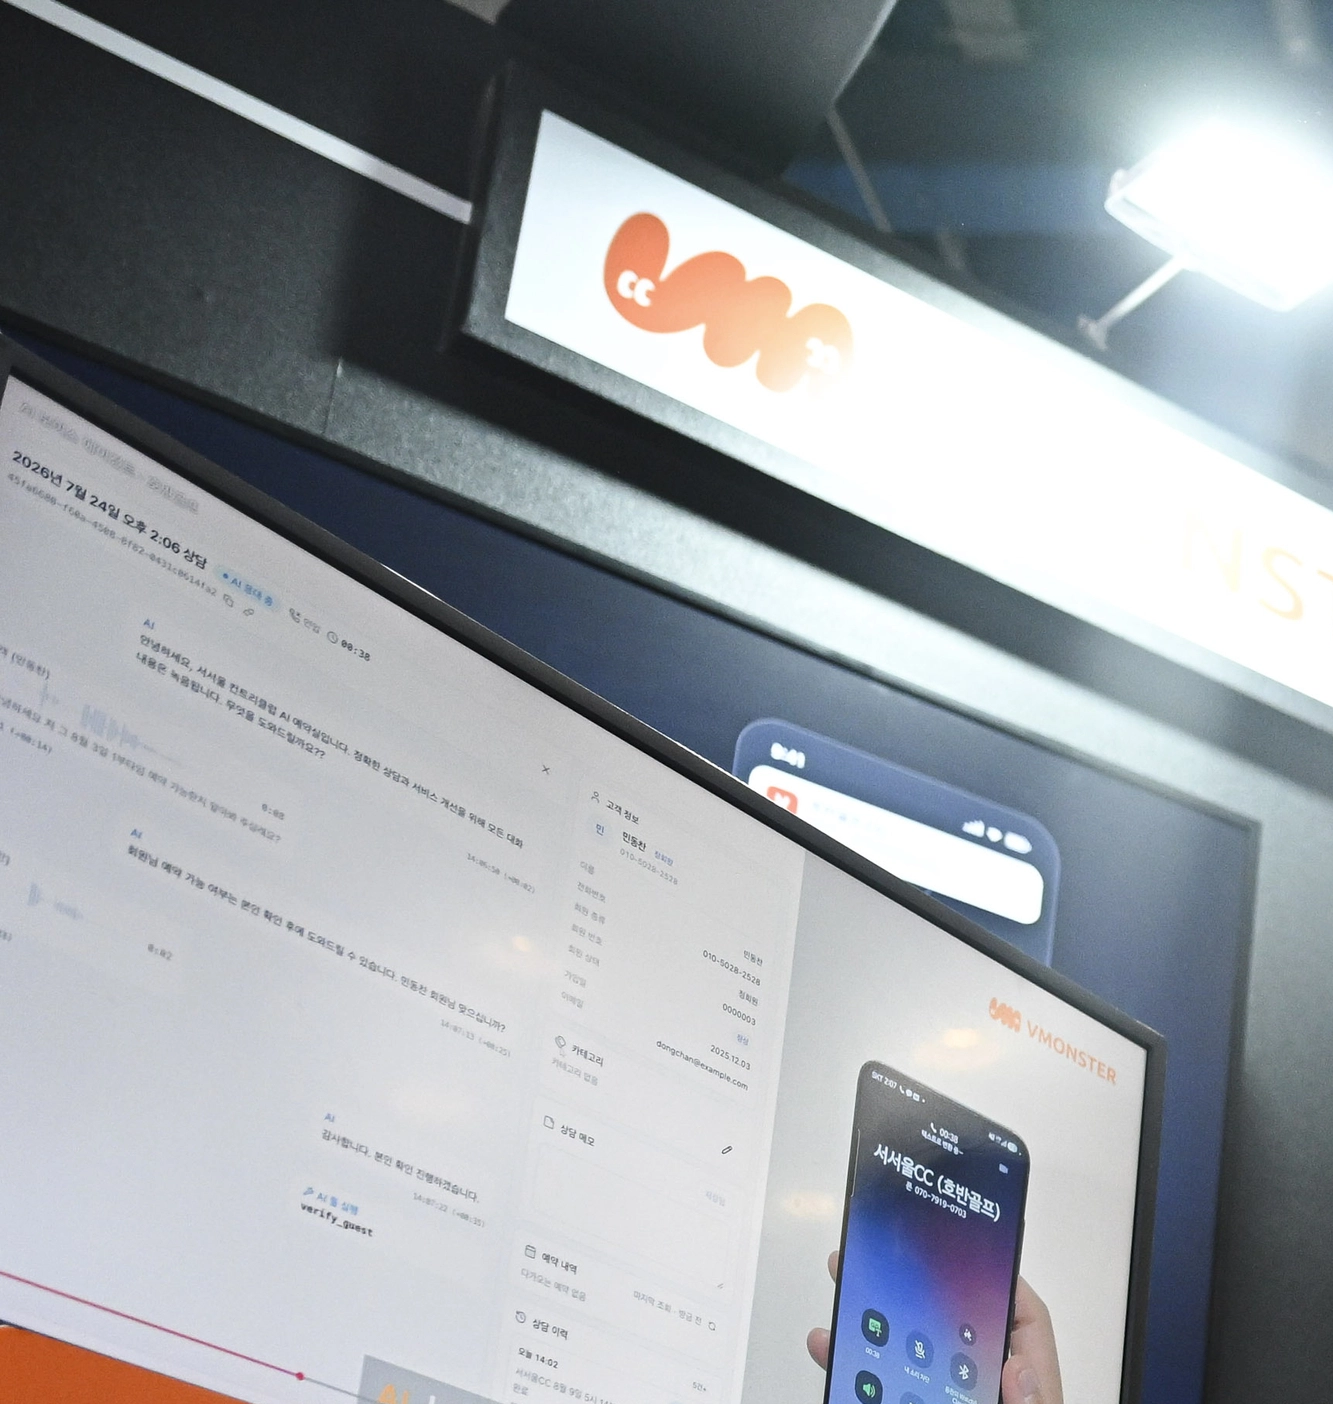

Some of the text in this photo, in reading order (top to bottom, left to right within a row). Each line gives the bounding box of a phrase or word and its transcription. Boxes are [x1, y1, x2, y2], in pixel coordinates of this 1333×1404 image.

[11, 448, 62, 488] 2026년
[65, 479, 86, 502] 7월
[89, 492, 120, 521] 24일
[122, 511, 147, 536] 오후
[149, 527, 181, 555] 2:06
[182, 545, 207, 570] 상담
[143, 617, 154, 630] AI
[340, 638, 370, 662] 00:38
[135, 651, 166, 676] 내용은
[225, 698, 254, 723] 무엇을
[257, 715, 325, 760] 도와드릴까요??
[139, 634, 193, 672] 안녕하세요,
[228, 682, 276, 716] 컨트리클럽
[279, 709, 290, 724] AI
[382, 764, 409, 788] 상담과
[411, 780, 437, 803] 서비스
[440, 795, 465, 818] 개선을
[468, 810, 485, 828] 위해
[487, 821, 504, 838] 모든
[506, 831, 523, 848] 대화
[606, 799, 639, 826] 고객 정보
[130, 827, 142, 840] AI
[595, 822, 604, 836] 민
[622, 830, 646, 853] 민동찬
[620, 847, 677, 885] 010-5028-2528
[127, 844, 158, 868] 회원님
[160, 859, 182, 880] 예약
[184, 871, 205, 891] 가능
[347, 948, 356, 962] 수
[429, 987, 456, 1009] 회원님
[702, 949, 760, 987] 010-5028-2528
[743, 949, 762, 967] 민동찬
[738, 989, 758, 1007] 정회원
[722, 1002, 755, 1026] 0000003
[571, 1043, 603, 1067] 카테고리
[656, 1038, 748, 1092] dongchan@example.com
[709, 1043, 750, 1071] 2025.12.03
[1026, 1018, 1117, 1086] VMONSTER
[560, 1123, 595, 1148] 상담 메모
[939, 1127, 958, 1144] 00:38
[321, 1127, 480, 1203] 감사합니다. 본인 확인 진행하겠습니다.
[873, 1140, 1001, 1222] 서서울CC (호반골프)
[300, 1200, 373, 1239] verify_guest
[541, 1250, 578, 1275] 예약 내역
[532, 1316, 568, 1341] 상담 이력
[517, 1346, 558, 1370] 오늘 14:02
[515, 1366, 551, 1388] 서서울CC
[583, 1391, 597, 1404] 5시
